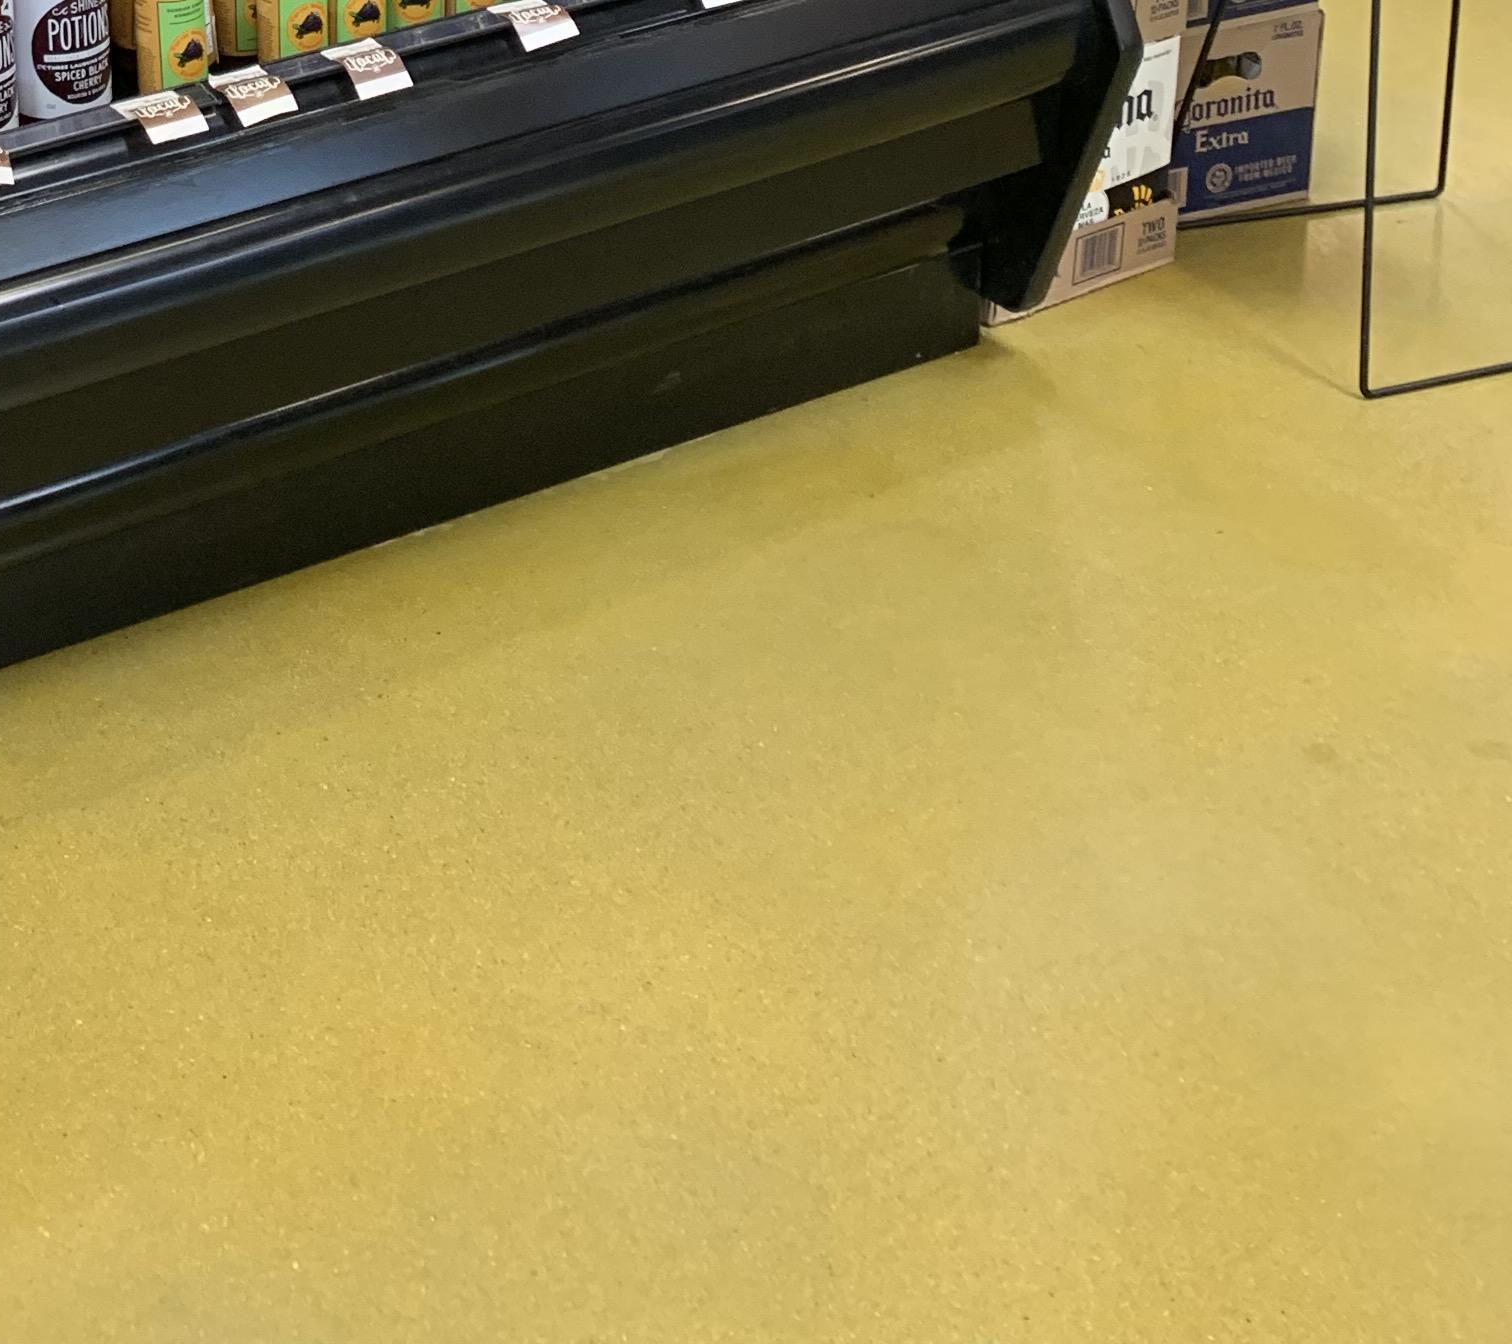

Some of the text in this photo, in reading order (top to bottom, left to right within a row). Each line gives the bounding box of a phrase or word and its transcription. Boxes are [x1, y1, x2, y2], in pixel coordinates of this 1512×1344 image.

[55, 61, 110, 82] SPICED BLACK
[74, 78, 103, 92] CHERRY
